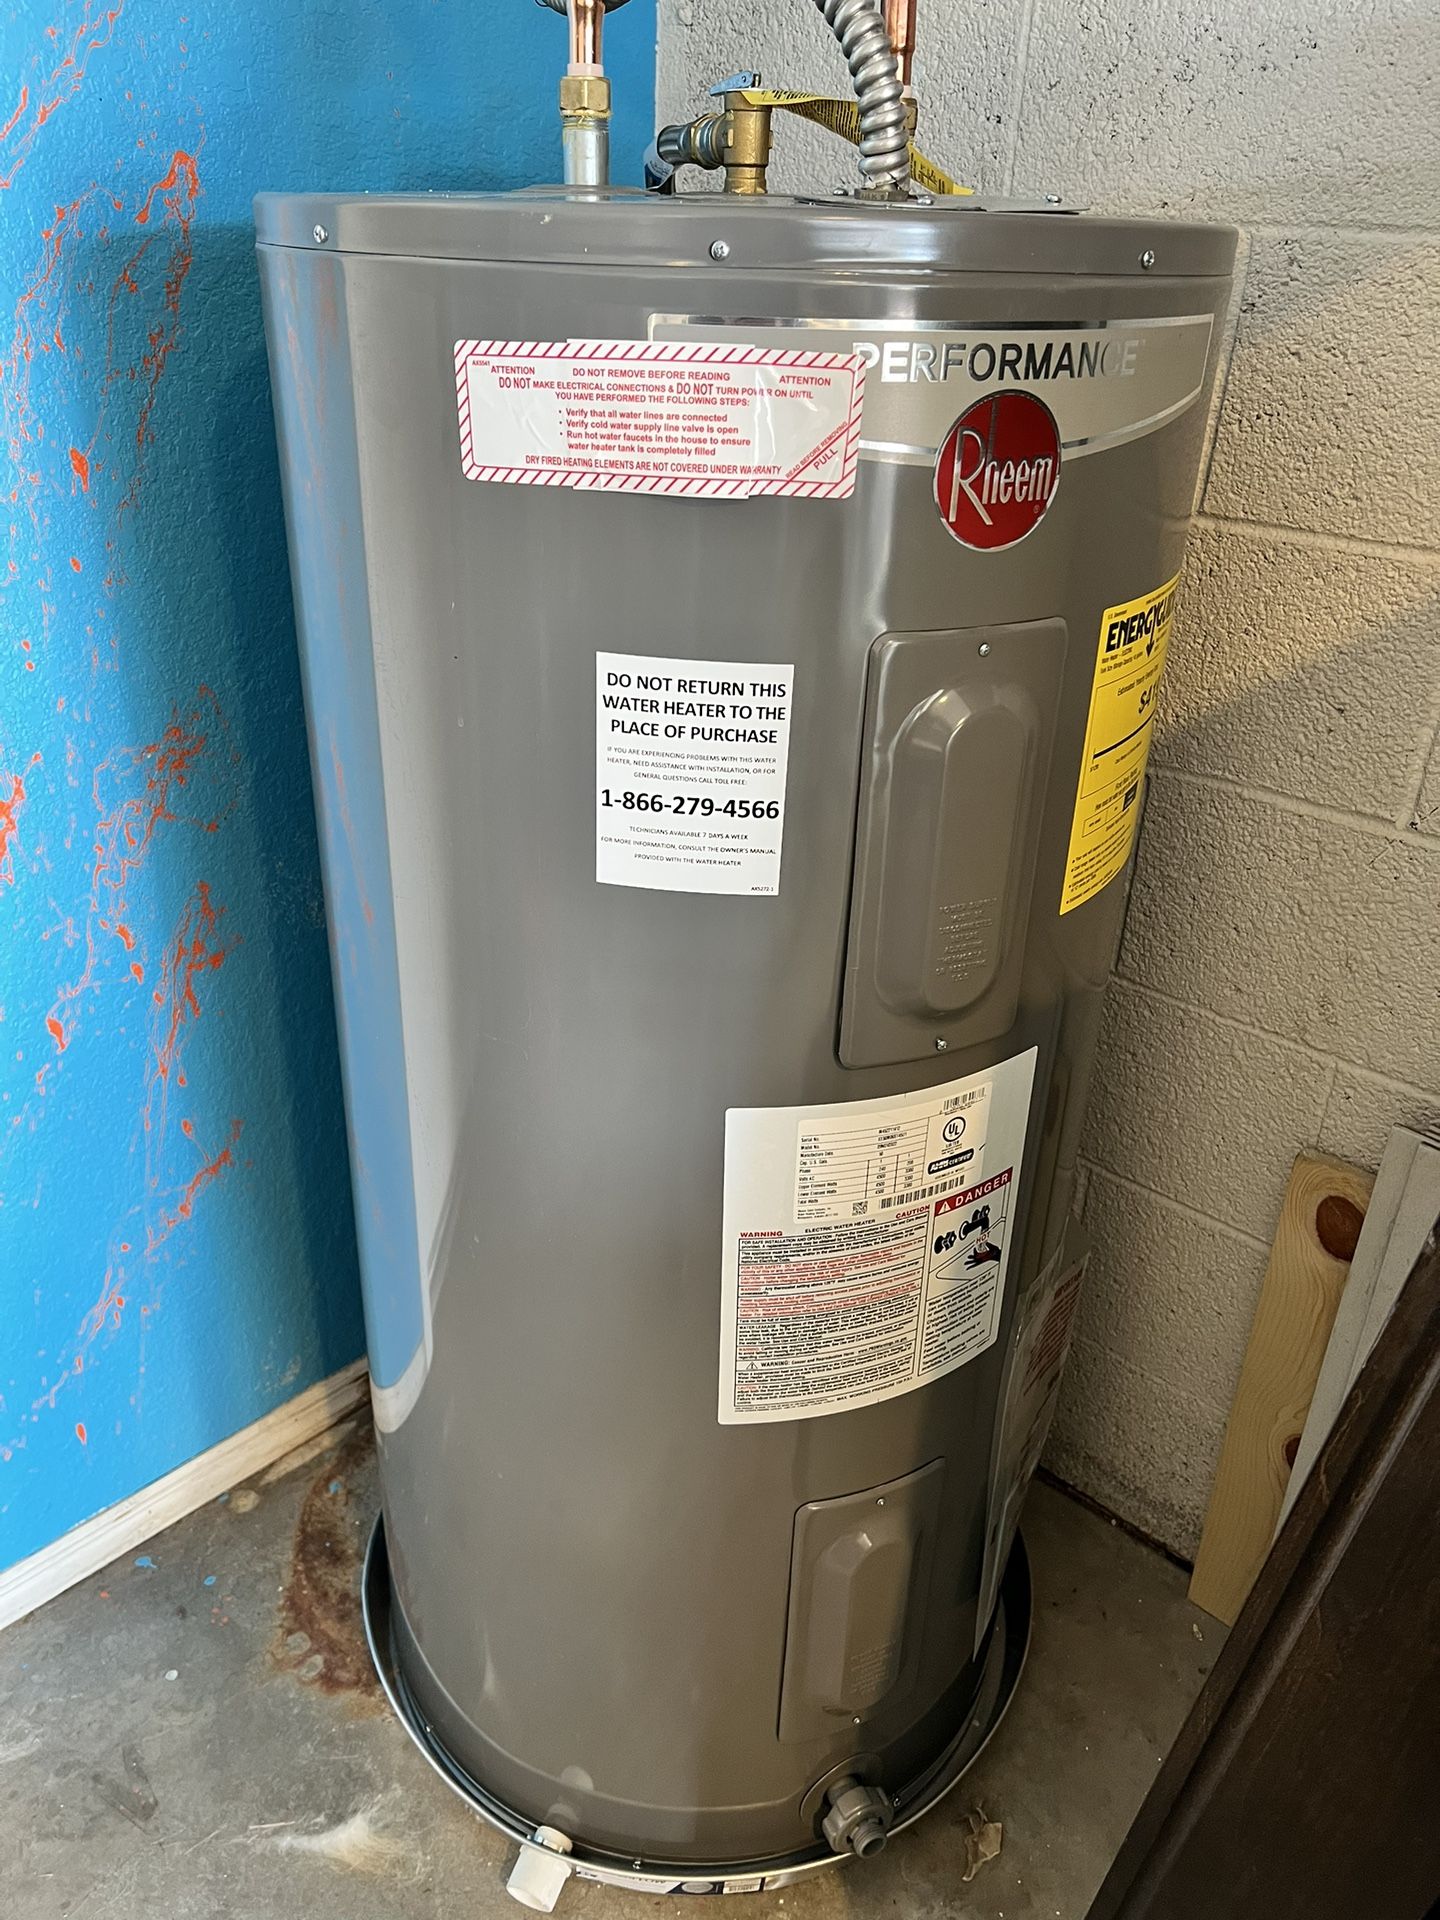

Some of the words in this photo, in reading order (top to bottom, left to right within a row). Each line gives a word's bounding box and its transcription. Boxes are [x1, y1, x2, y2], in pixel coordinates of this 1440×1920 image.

[853, 342, 1139, 383] PERFORMANCE
[491, 366, 535, 375] ATTENTION
[572, 368, 585, 377] DO
[588, 369, 605, 377] NOT
[608, 370, 645, 378] REMOVE
[648, 370, 685, 380] BEFORE
[688, 372, 730, 381] READING
[500, 377, 511, 389] DO
[514, 378, 531, 389] NOT
[533, 381, 555, 389] MAKE
[557, 382, 605, 391] ELECTRICAL
[607, 384, 666, 393] CONNECTIONS
[676, 383, 691, 395] DO
[694, 384, 713, 395] NOT
[716, 387, 739, 396] TURN
[774, 389, 787, 397] ON
[790, 391, 814, 399] UNTIL
[779, 376, 831, 386] ATTENTION
[556, 392, 572, 400] YOU
[574, 393, 594, 401] HAVE
[596, 394, 645, 402] PERFORMED
[667, 396, 717, 405] FOLLOWING
[566, 408, 588, 418] Verify
[590, 410, 606, 418] that
[644, 412, 664, 420] lines
[682, 414, 727, 422] connected
[566, 420, 588, 430] Verify
[590, 421, 608, 429] cold
[634, 422, 661, 433] supply
[664, 423, 679, 432] line
[682, 424, 704, 433] valve
[707, 425, 714, 433] is
[567, 431, 583, 439] Run
[585, 431, 598, 440] hot
[624, 432, 653, 442] faucets
[666, 435, 678, 443] the
[681, 436, 707, 444] house
[710, 437, 719, 445] to
[591, 442, 616, 451] heater
[618, 444, 635, 452] tank
[638, 445, 644, 453] is
[646, 446, 692, 456] completely
[695, 447, 716, 456] filled
[786, 464, 801, 478] READ
[800, 445, 821, 465] BEFORE
[820, 421, 848, 447] REMOVING
[526, 455, 541, 464] DRY
[542, 456, 561, 466] FIRED
[564, 457, 593, 468] HEATING
[594, 460, 634, 470] ELEMENTS
[636, 461, 651, 471] ARE
[653, 462, 669, 472] NOT
[670, 463, 708, 473] COVERED
[710, 464, 737, 474] UNDER
[814, 448, 838, 470] PULL
[949, 399, 1053, 525] Rheem
[608, 673, 631, 688] DO
[637, 676, 672, 691] NOT
[678, 680, 744, 696] RETURN
[750, 683, 786, 698] THIS
[602, 694, 660, 713] WATER
[664, 701, 726, 718] HEATER
[730, 705, 752, 719] TO
[756, 706, 786, 720] THE
[612, 719, 659, 737] PLACE
[664, 725, 686, 738] OF
[691, 727, 778, 743] PURCHASE
[642, 750, 685, 759] EXPERIENCING
[608, 758, 631, 766] HEATER,
[651, 762, 686, 770] ASSISTANCE
[706, 766, 751, 774] INSTALLATION,
[602, 789, 780, 819] 1-866-279-4566
[630, 826, 668, 835] TECHNICIANS
[633, 840, 677, 850] INFORMATION,
[949, 1124, 960, 1136] UL
[955, 1173, 1009, 1206] DANGER
[896, 1204, 930, 1219] CAUTION
[976, 1232, 990, 1244] HOT
